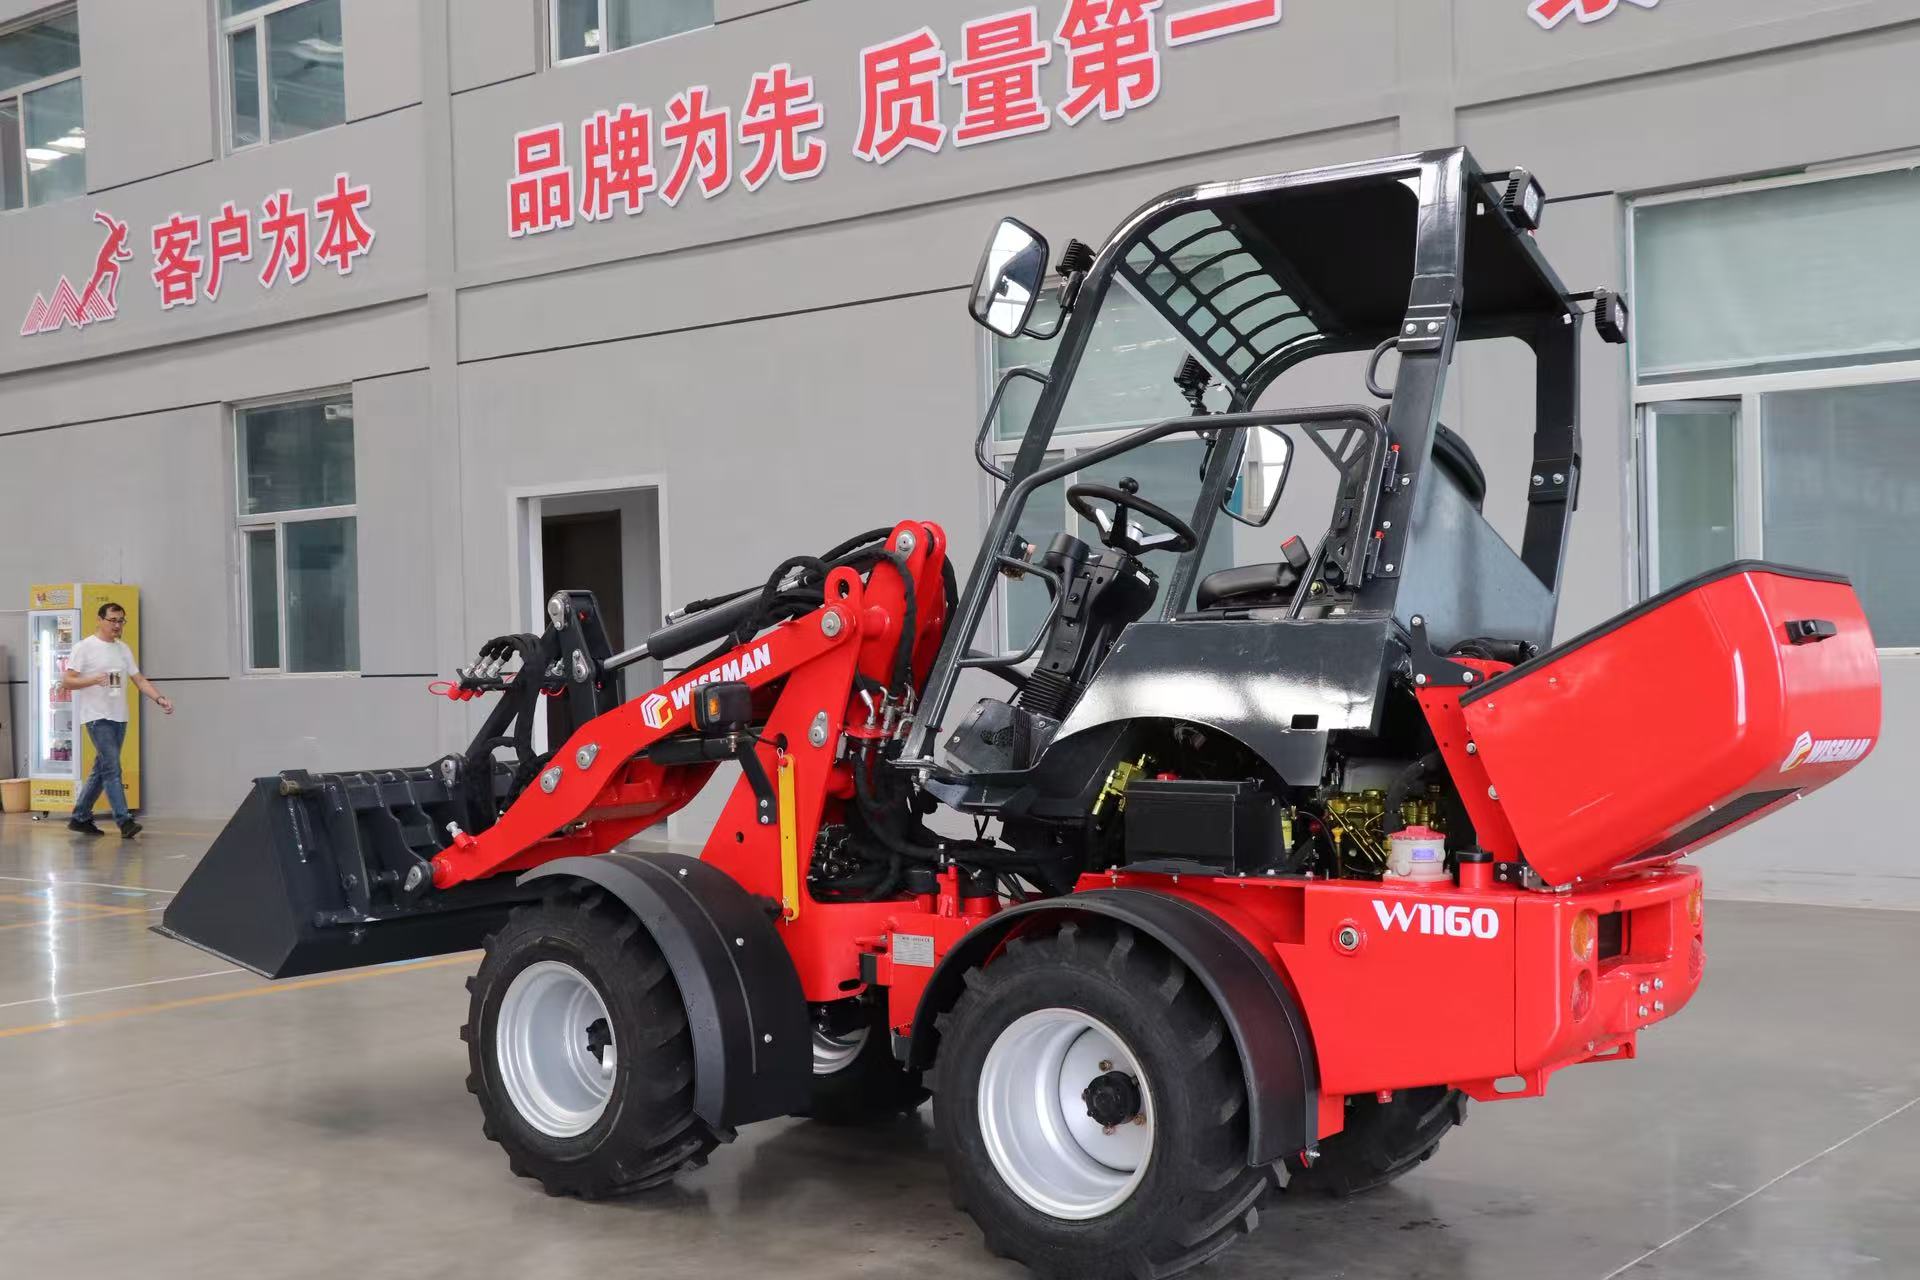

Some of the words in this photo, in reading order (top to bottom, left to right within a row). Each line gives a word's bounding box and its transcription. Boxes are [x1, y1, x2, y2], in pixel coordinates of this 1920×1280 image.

[511, 68, 823, 231] 品牌为先
[858, 0, 1275, 157] 质量第一
[154, 177, 370, 304] 客户为本
[1371, 899, 1499, 939] W1160
